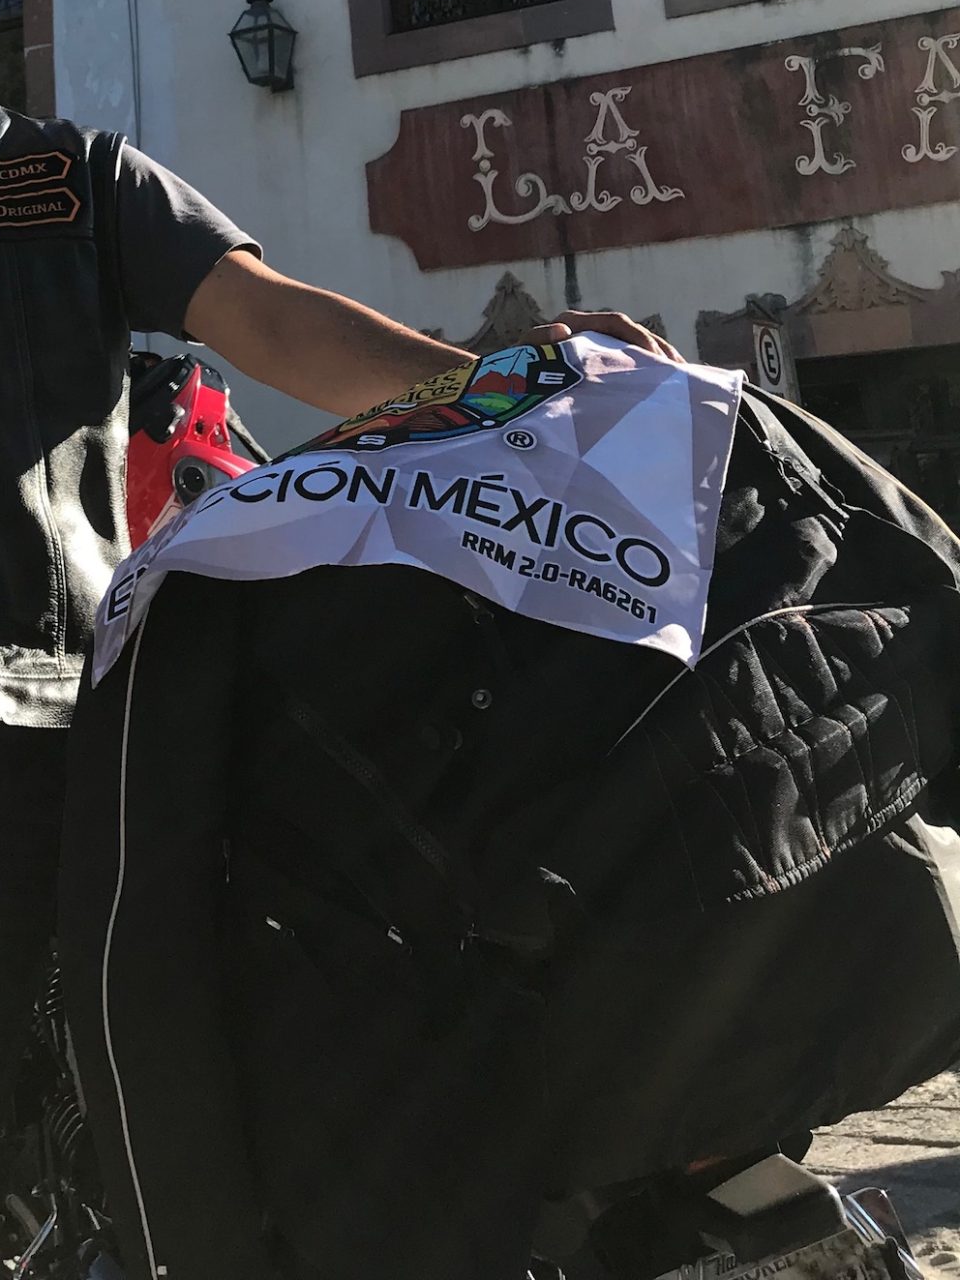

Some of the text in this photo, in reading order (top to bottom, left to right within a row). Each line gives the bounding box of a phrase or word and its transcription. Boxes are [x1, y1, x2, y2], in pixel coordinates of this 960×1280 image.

[459, 86, 686, 232] LA
[763, 341, 777, 375] E
[408, 471, 671, 588] MÉXICO
[461, 530, 517, 571] RRM
